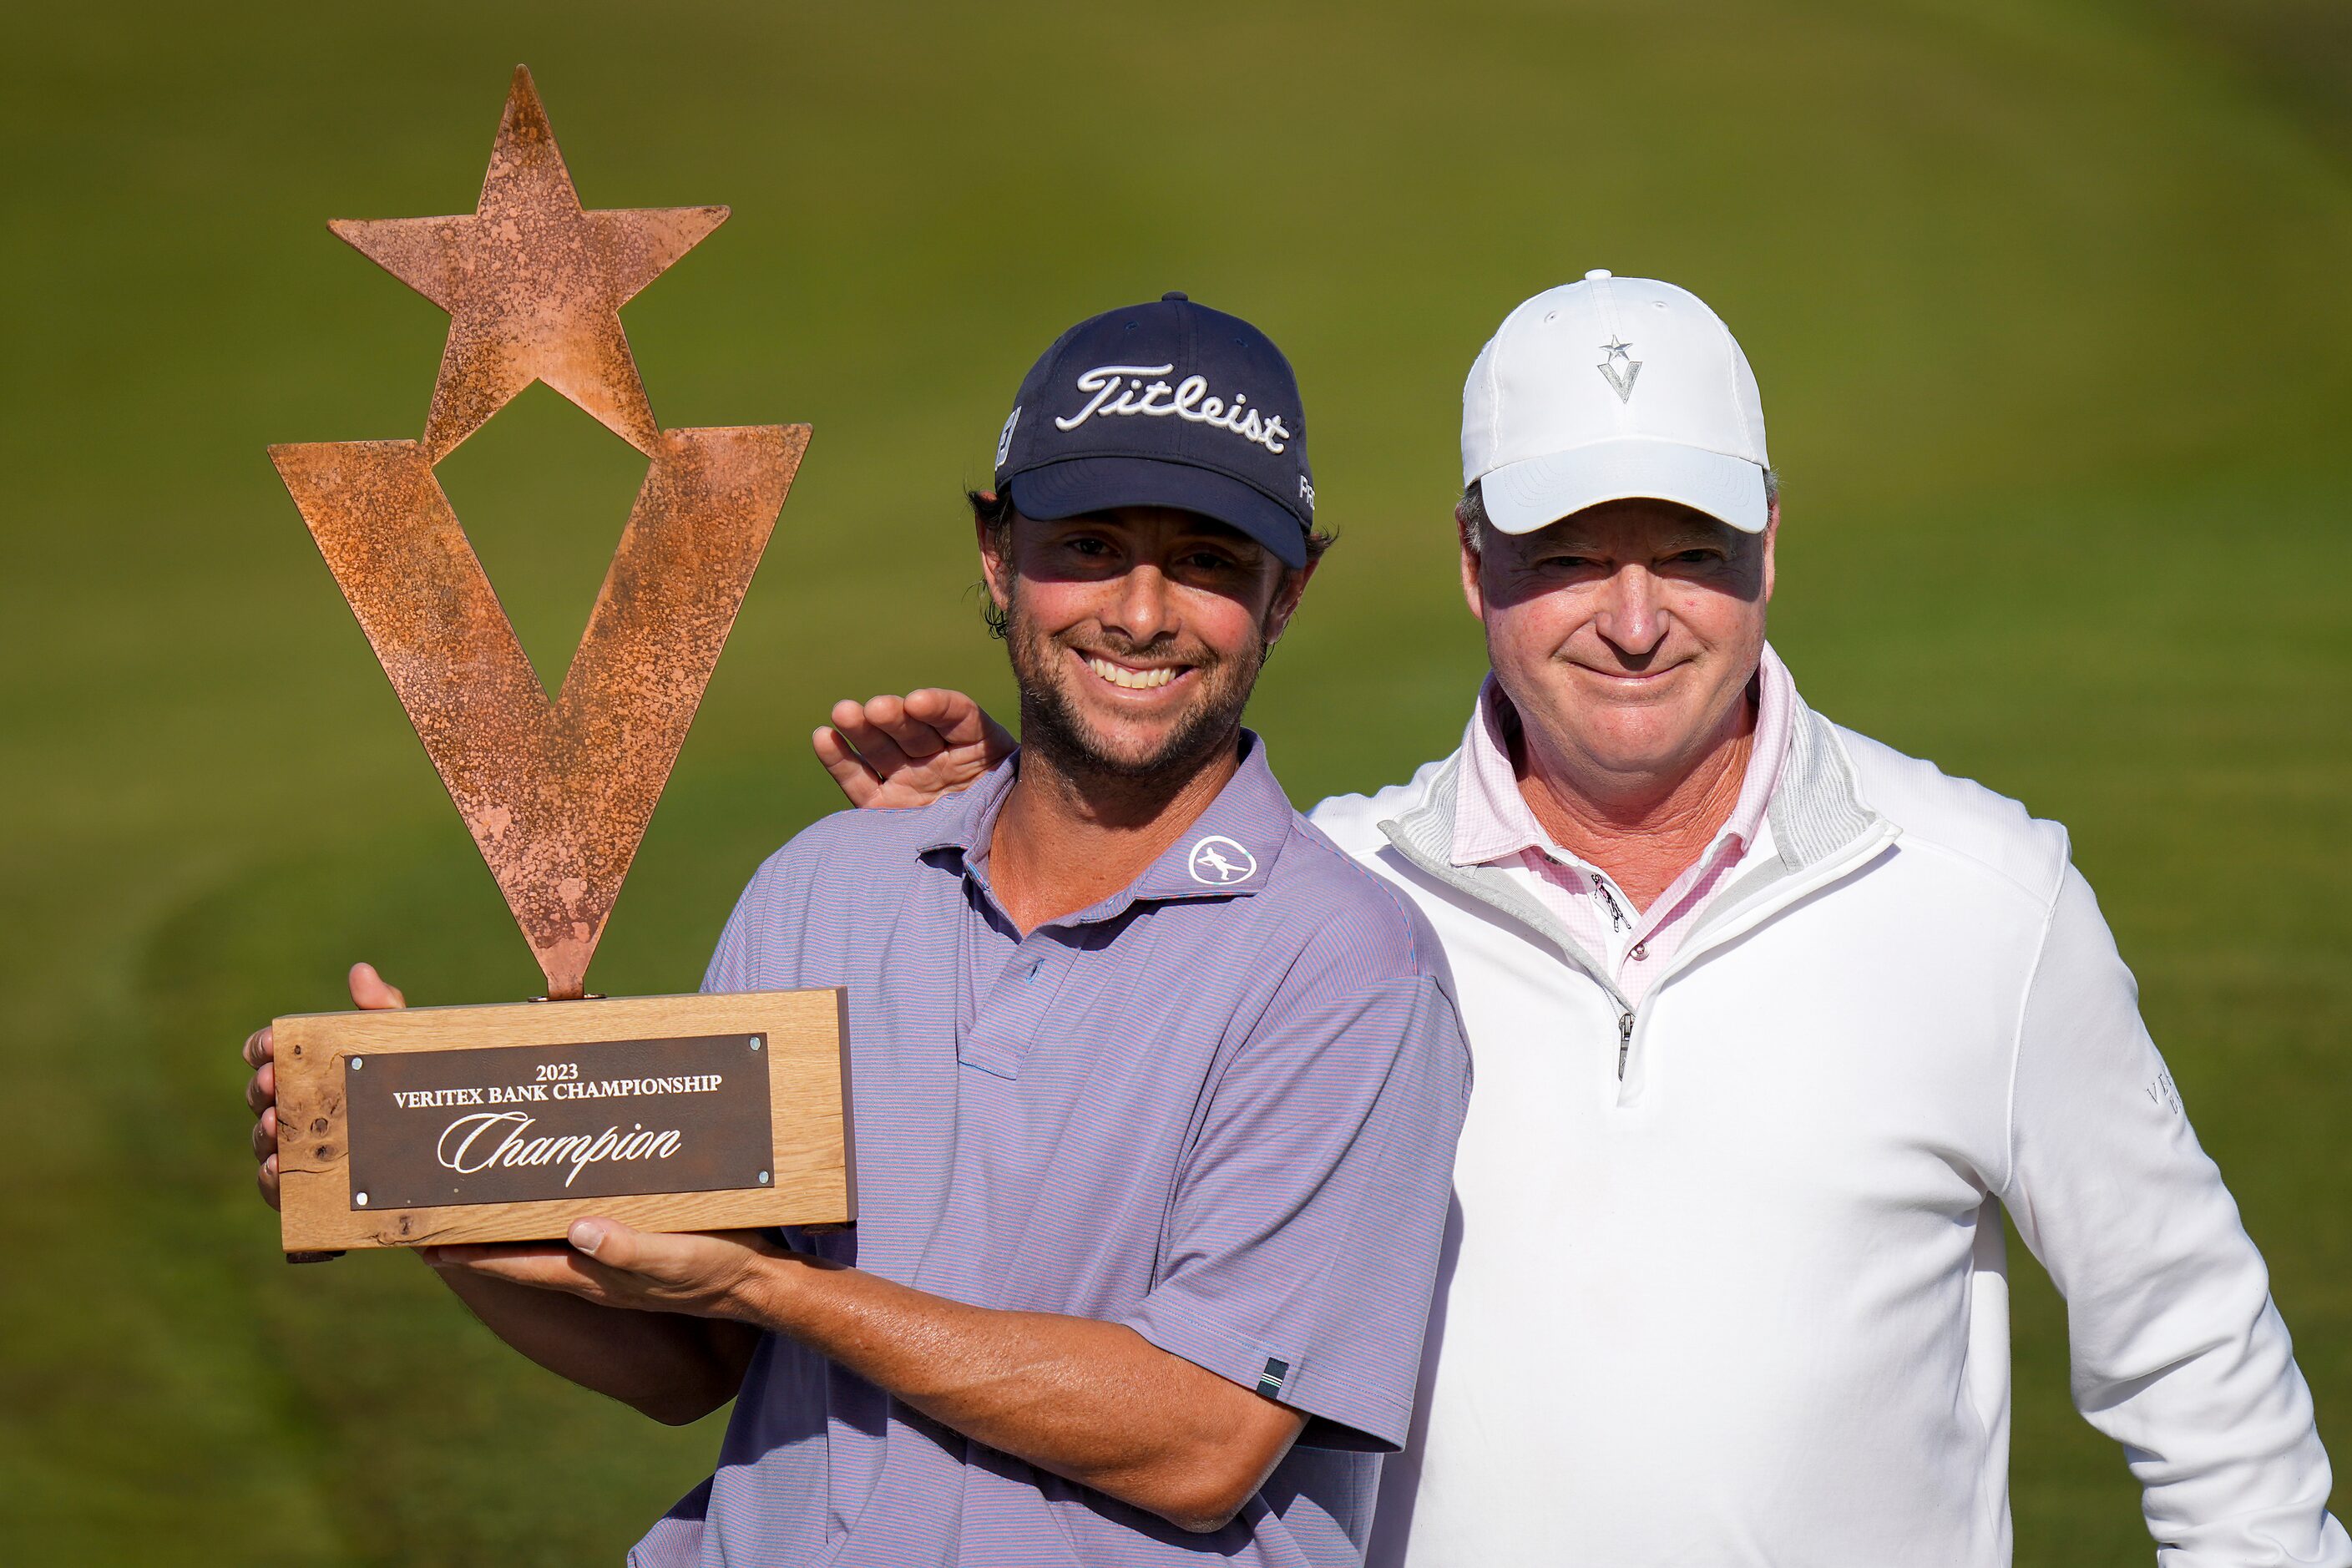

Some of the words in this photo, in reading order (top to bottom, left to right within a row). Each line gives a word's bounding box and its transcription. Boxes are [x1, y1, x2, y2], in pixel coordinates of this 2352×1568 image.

[1055, 363, 1290, 454] Titleist
[392, 1087, 484, 1109] VERITEX
[488, 1084, 549, 1103] BANK
[553, 1075, 723, 1101] CHAMPIONSHIP
[535, 1063, 579, 1082] 2023
[437, 1110, 682, 1188] Champion
